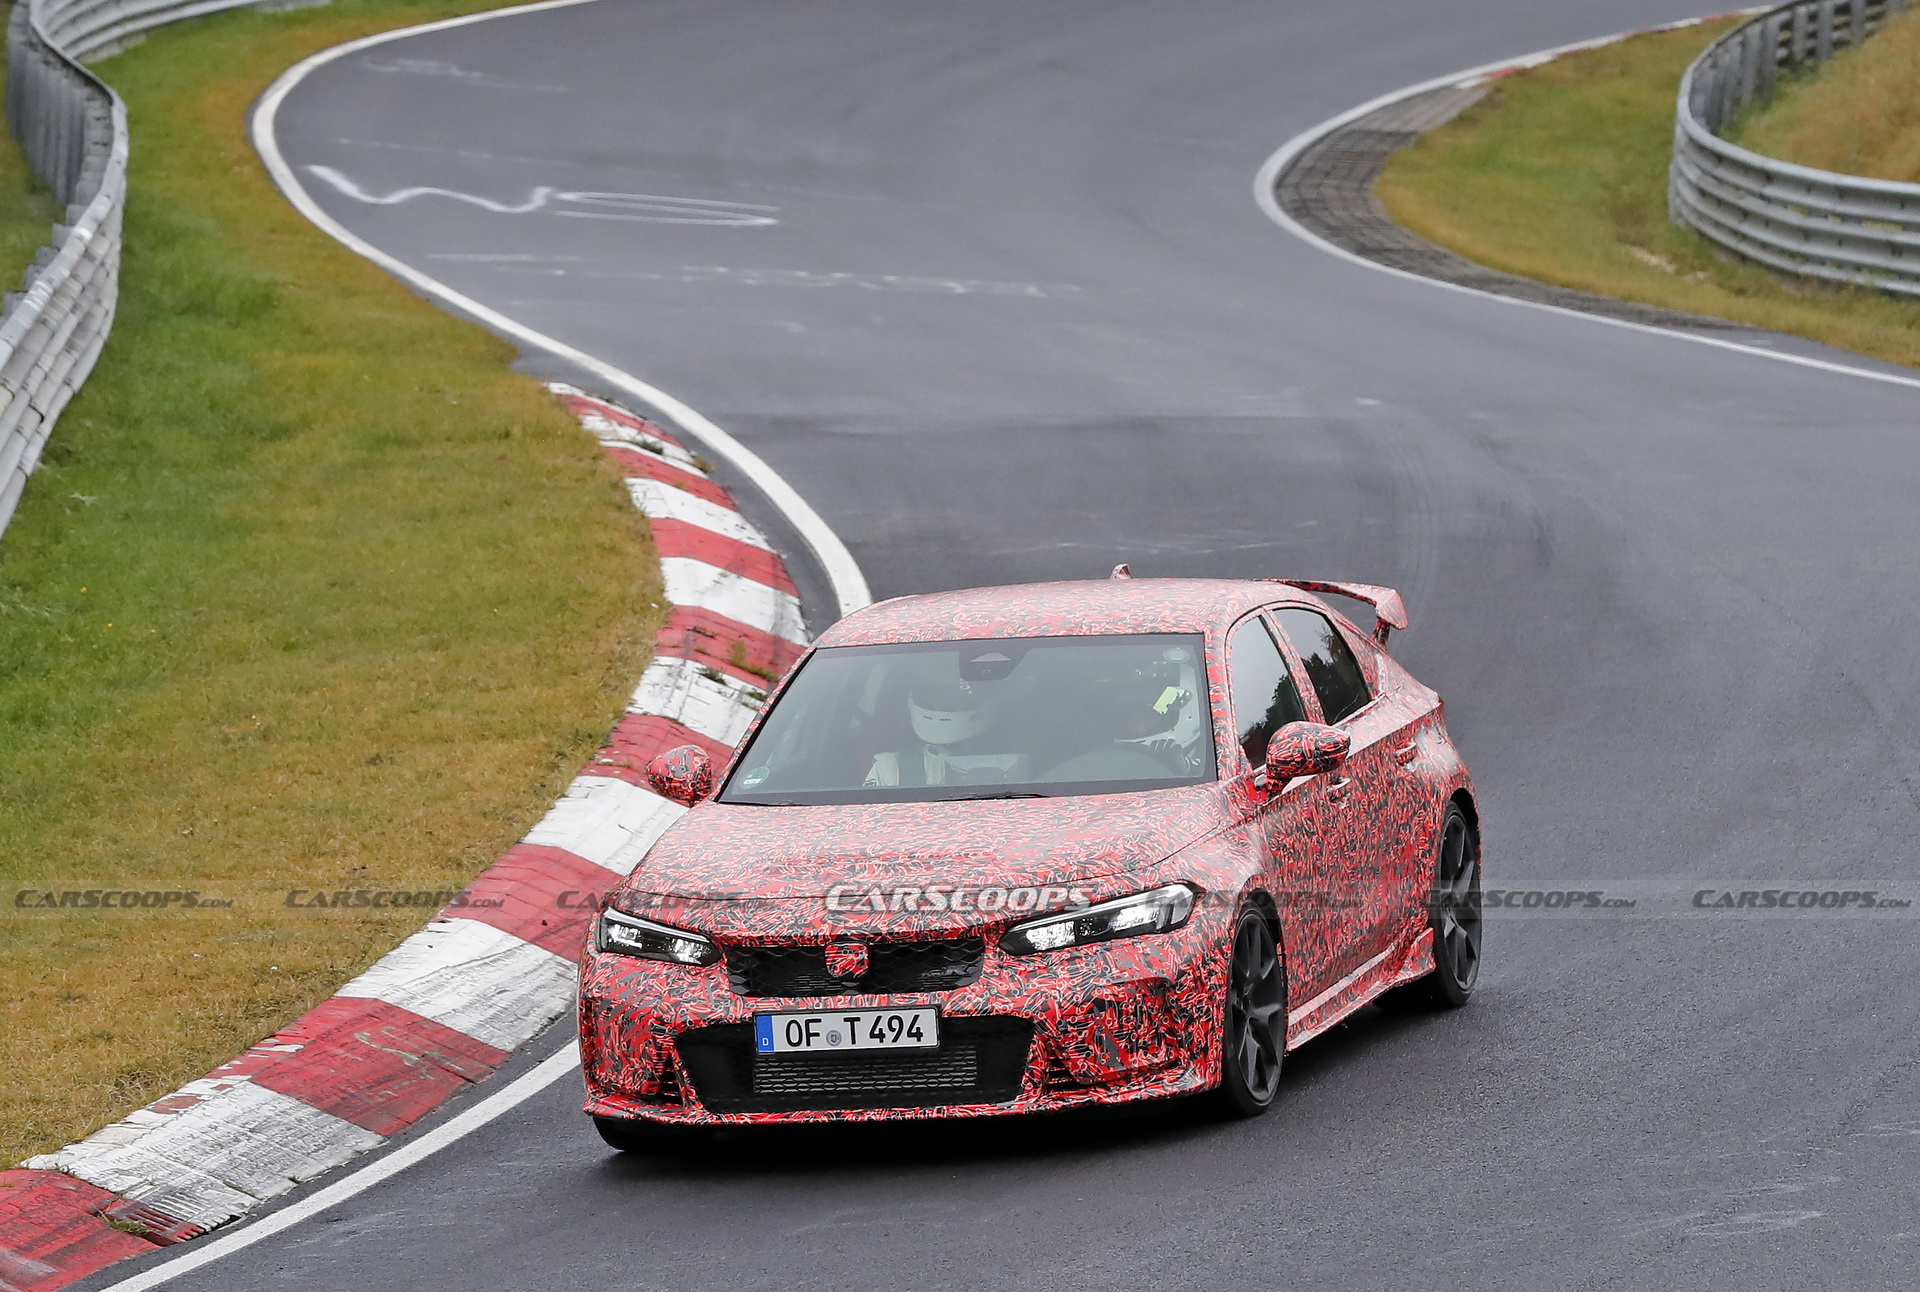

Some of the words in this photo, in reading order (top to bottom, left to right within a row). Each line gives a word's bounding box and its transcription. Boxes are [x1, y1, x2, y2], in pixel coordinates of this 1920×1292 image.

[785, 1018, 822, 1047] OF
[843, 1017, 861, 1045] T
[869, 1014, 924, 1044] 494
[761, 1037, 770, 1047] D
